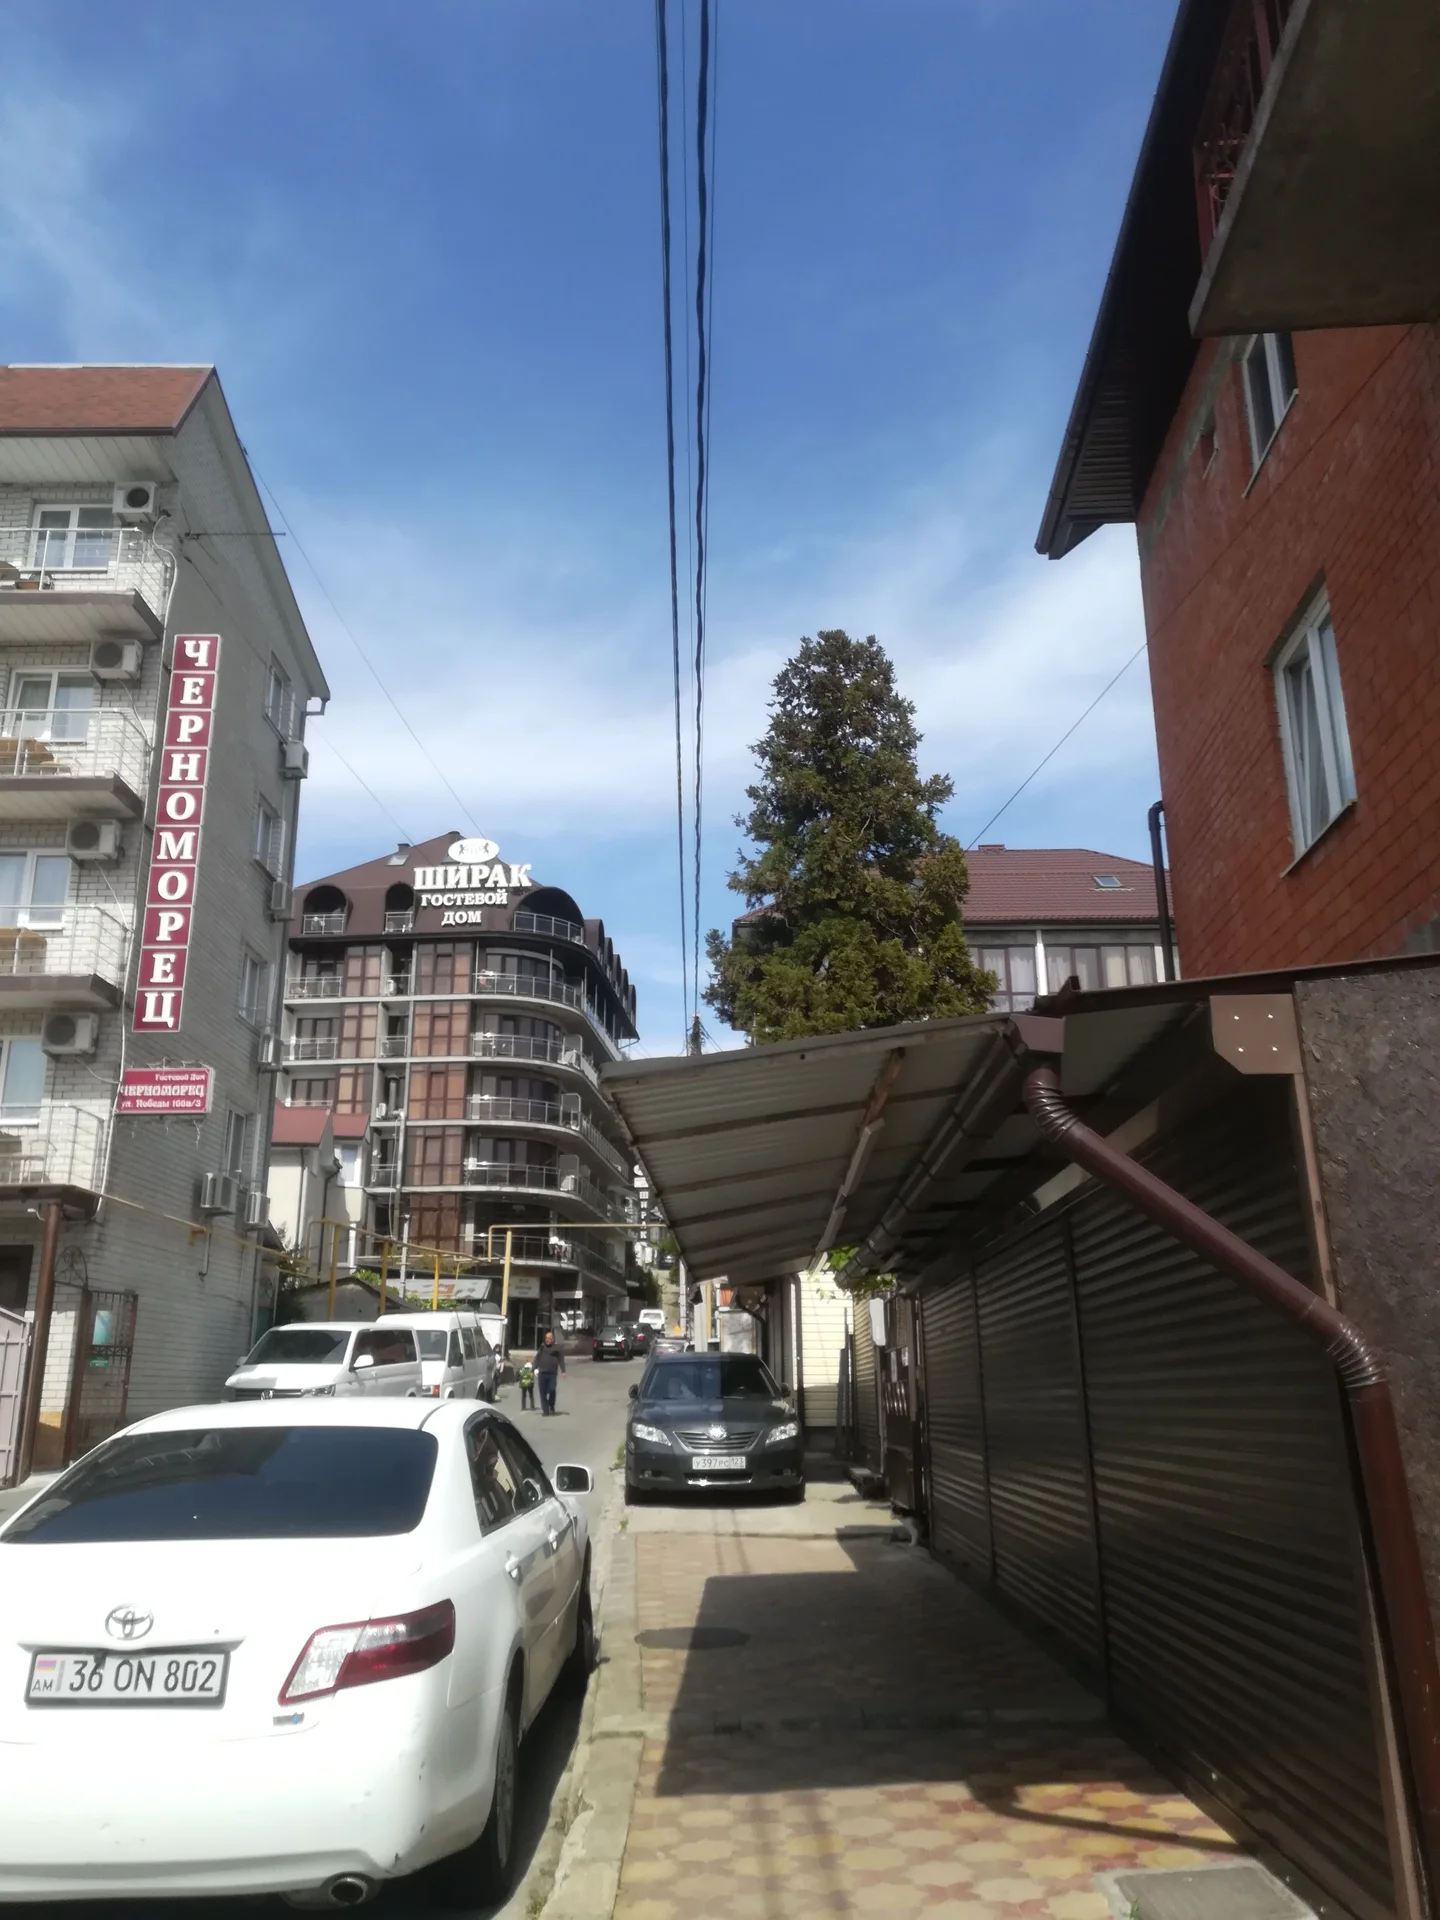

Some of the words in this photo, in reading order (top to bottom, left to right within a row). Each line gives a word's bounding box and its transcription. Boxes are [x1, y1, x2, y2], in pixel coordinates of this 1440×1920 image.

[141, 639, 210, 1028] ЧЕРНОМОРЕЦ
[413, 864, 532, 890] ШИРАК
[421, 889, 508, 907] ГОСТЕВОЙ
[441, 911, 482, 926] ДОМ
[190, 1073, 206, 1081] Дом
[121, 1085, 204, 1097] ЧЕРНОМОРЕЦ
[136, 1099, 169, 1108] Победы
[69, 1660, 103, 1692] 36
[113, 1659, 156, 1692] ON
[164, 1659, 217, 1692] 802
[32, 1679, 53, 1692] AM
